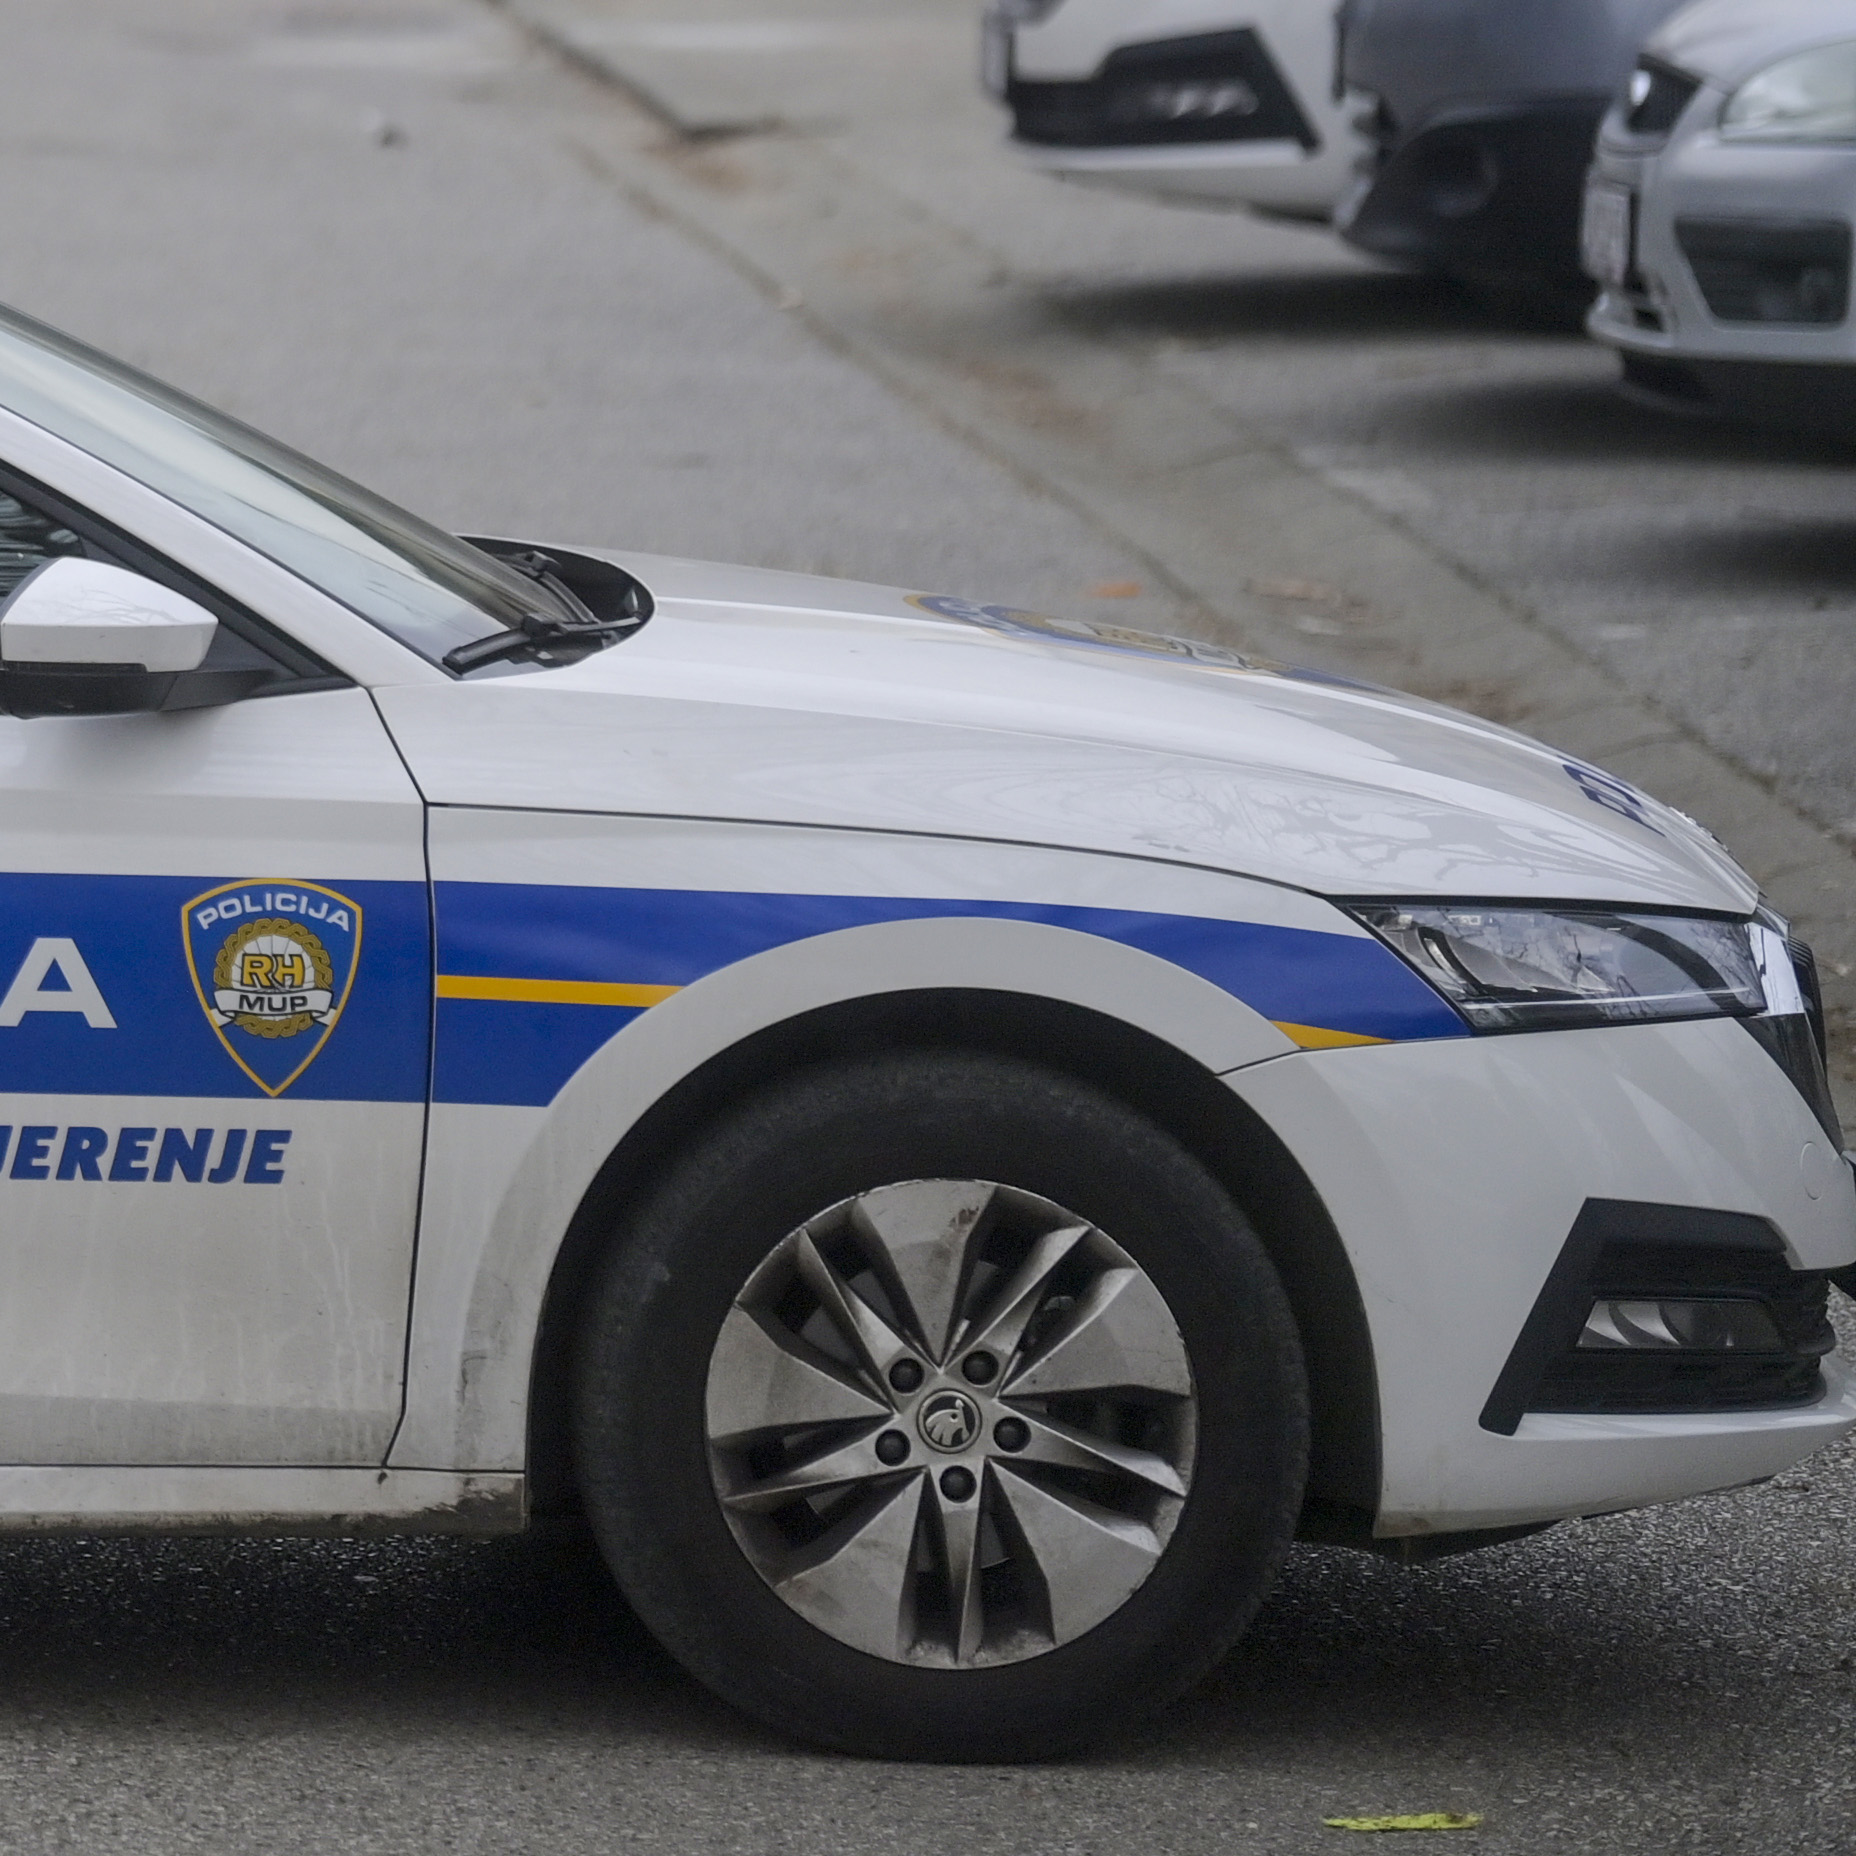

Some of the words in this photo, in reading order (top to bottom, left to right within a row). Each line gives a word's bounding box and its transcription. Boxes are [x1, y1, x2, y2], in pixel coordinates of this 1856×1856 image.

[196, 892, 350, 932] POLICIJA
[240, 952, 306, 989] RH
[238, 993, 309, 1014] MUP
